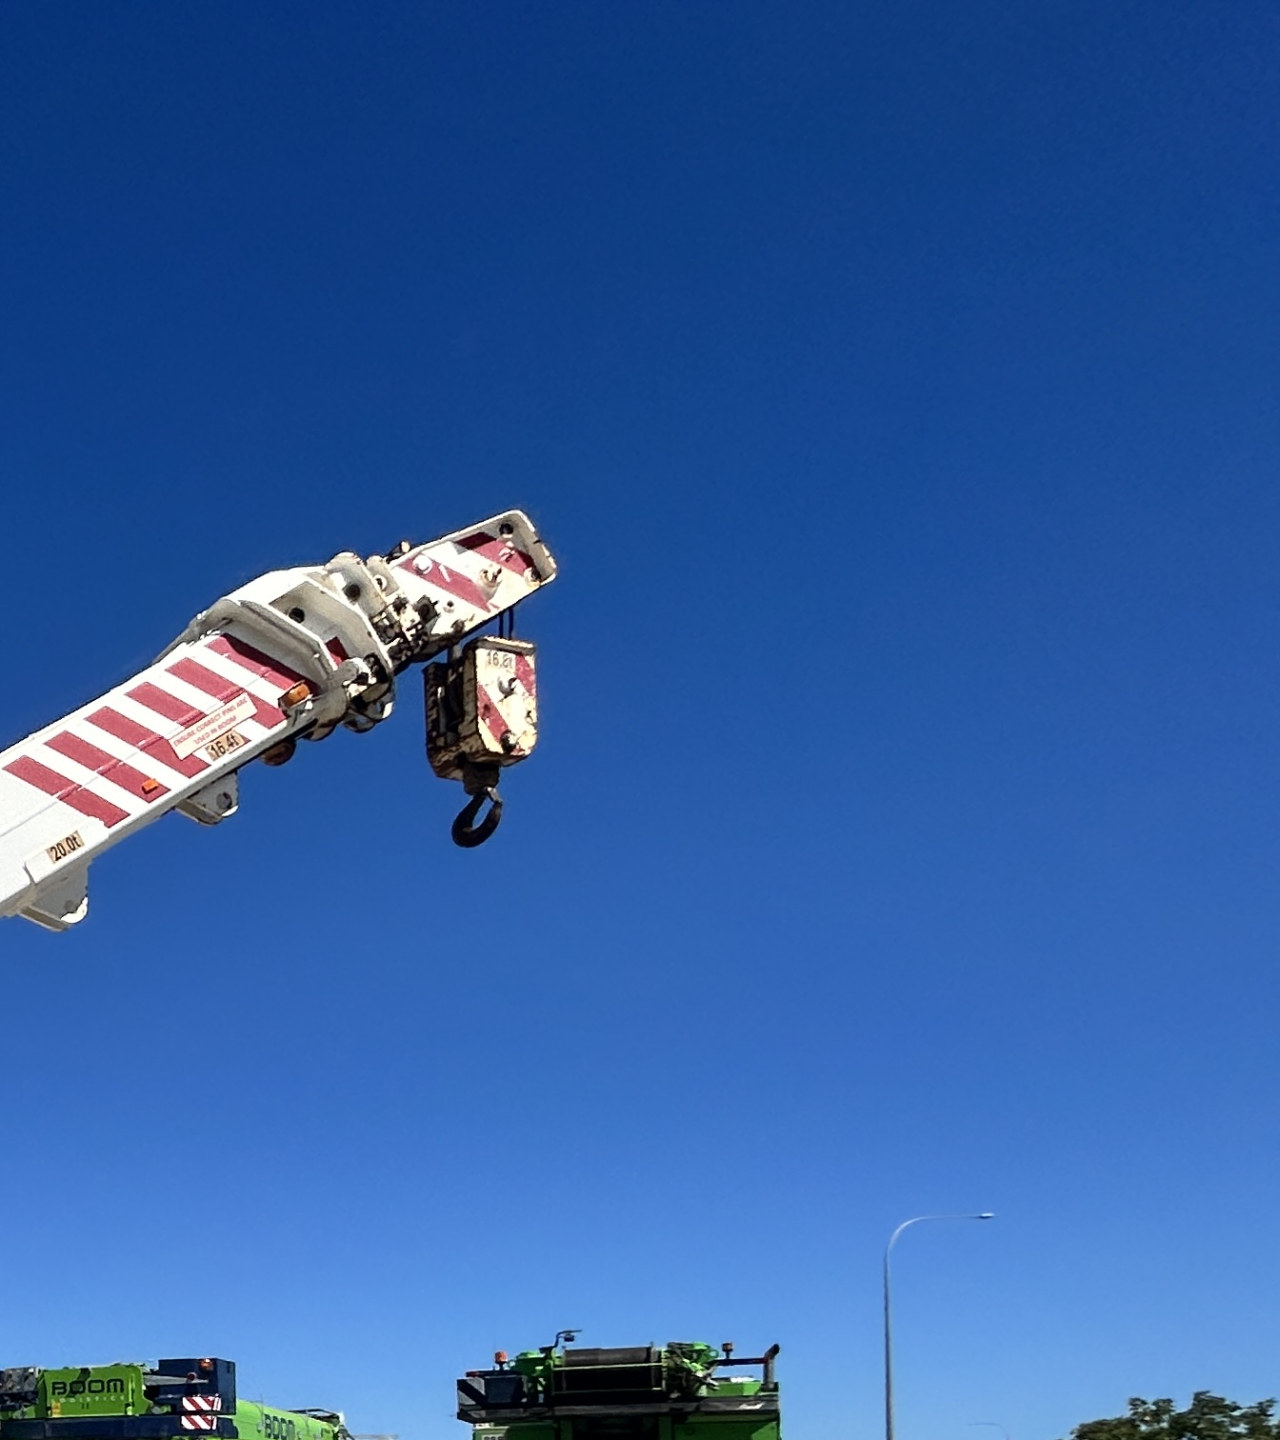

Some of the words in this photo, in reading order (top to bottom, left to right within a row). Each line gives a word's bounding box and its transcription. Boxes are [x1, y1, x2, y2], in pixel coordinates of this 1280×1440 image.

[211, 733, 240, 758] 16.4t
[51, 834, 81, 862] 20.0t
[51, 1378, 124, 1396] BOOM
